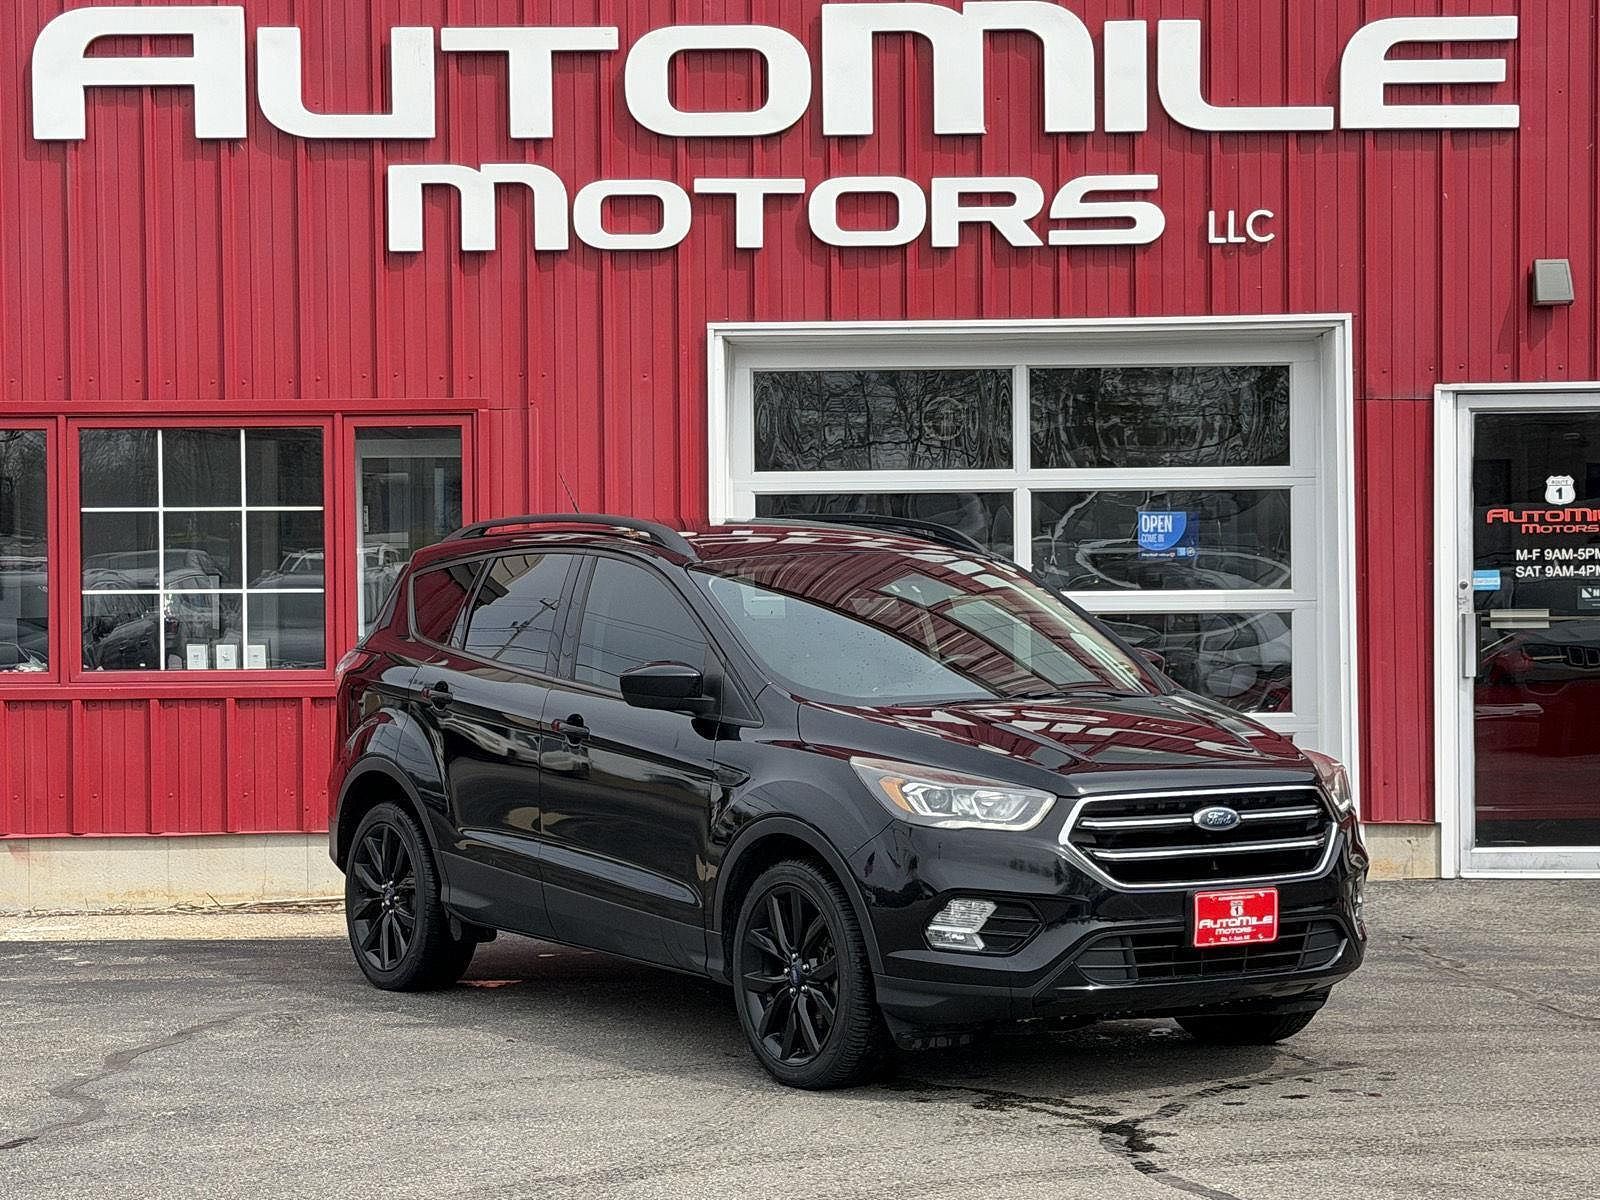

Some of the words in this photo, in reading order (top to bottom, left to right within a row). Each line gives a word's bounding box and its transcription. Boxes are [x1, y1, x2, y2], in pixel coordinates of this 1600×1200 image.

[32, 1, 1520, 140] AUTOMILE
[387, 163, 1166, 252] MOTORS
[1208, 209, 1275, 244] LLC
[1555, 487, 1563, 500] 1
[1486, 508, 1600, 523] AUTOMI
[1141, 515, 1173, 533] OPEN
[1521, 524, 1600, 534] MOTORS
[1515, 549, 1541, 561] M-F
[1515, 566, 1542, 578] SAT
[1207, 811, 1232, 825] Ford
[1198, 915, 1274, 929] AUTOMILE
[1215, 926, 1252, 935] MOTORS
